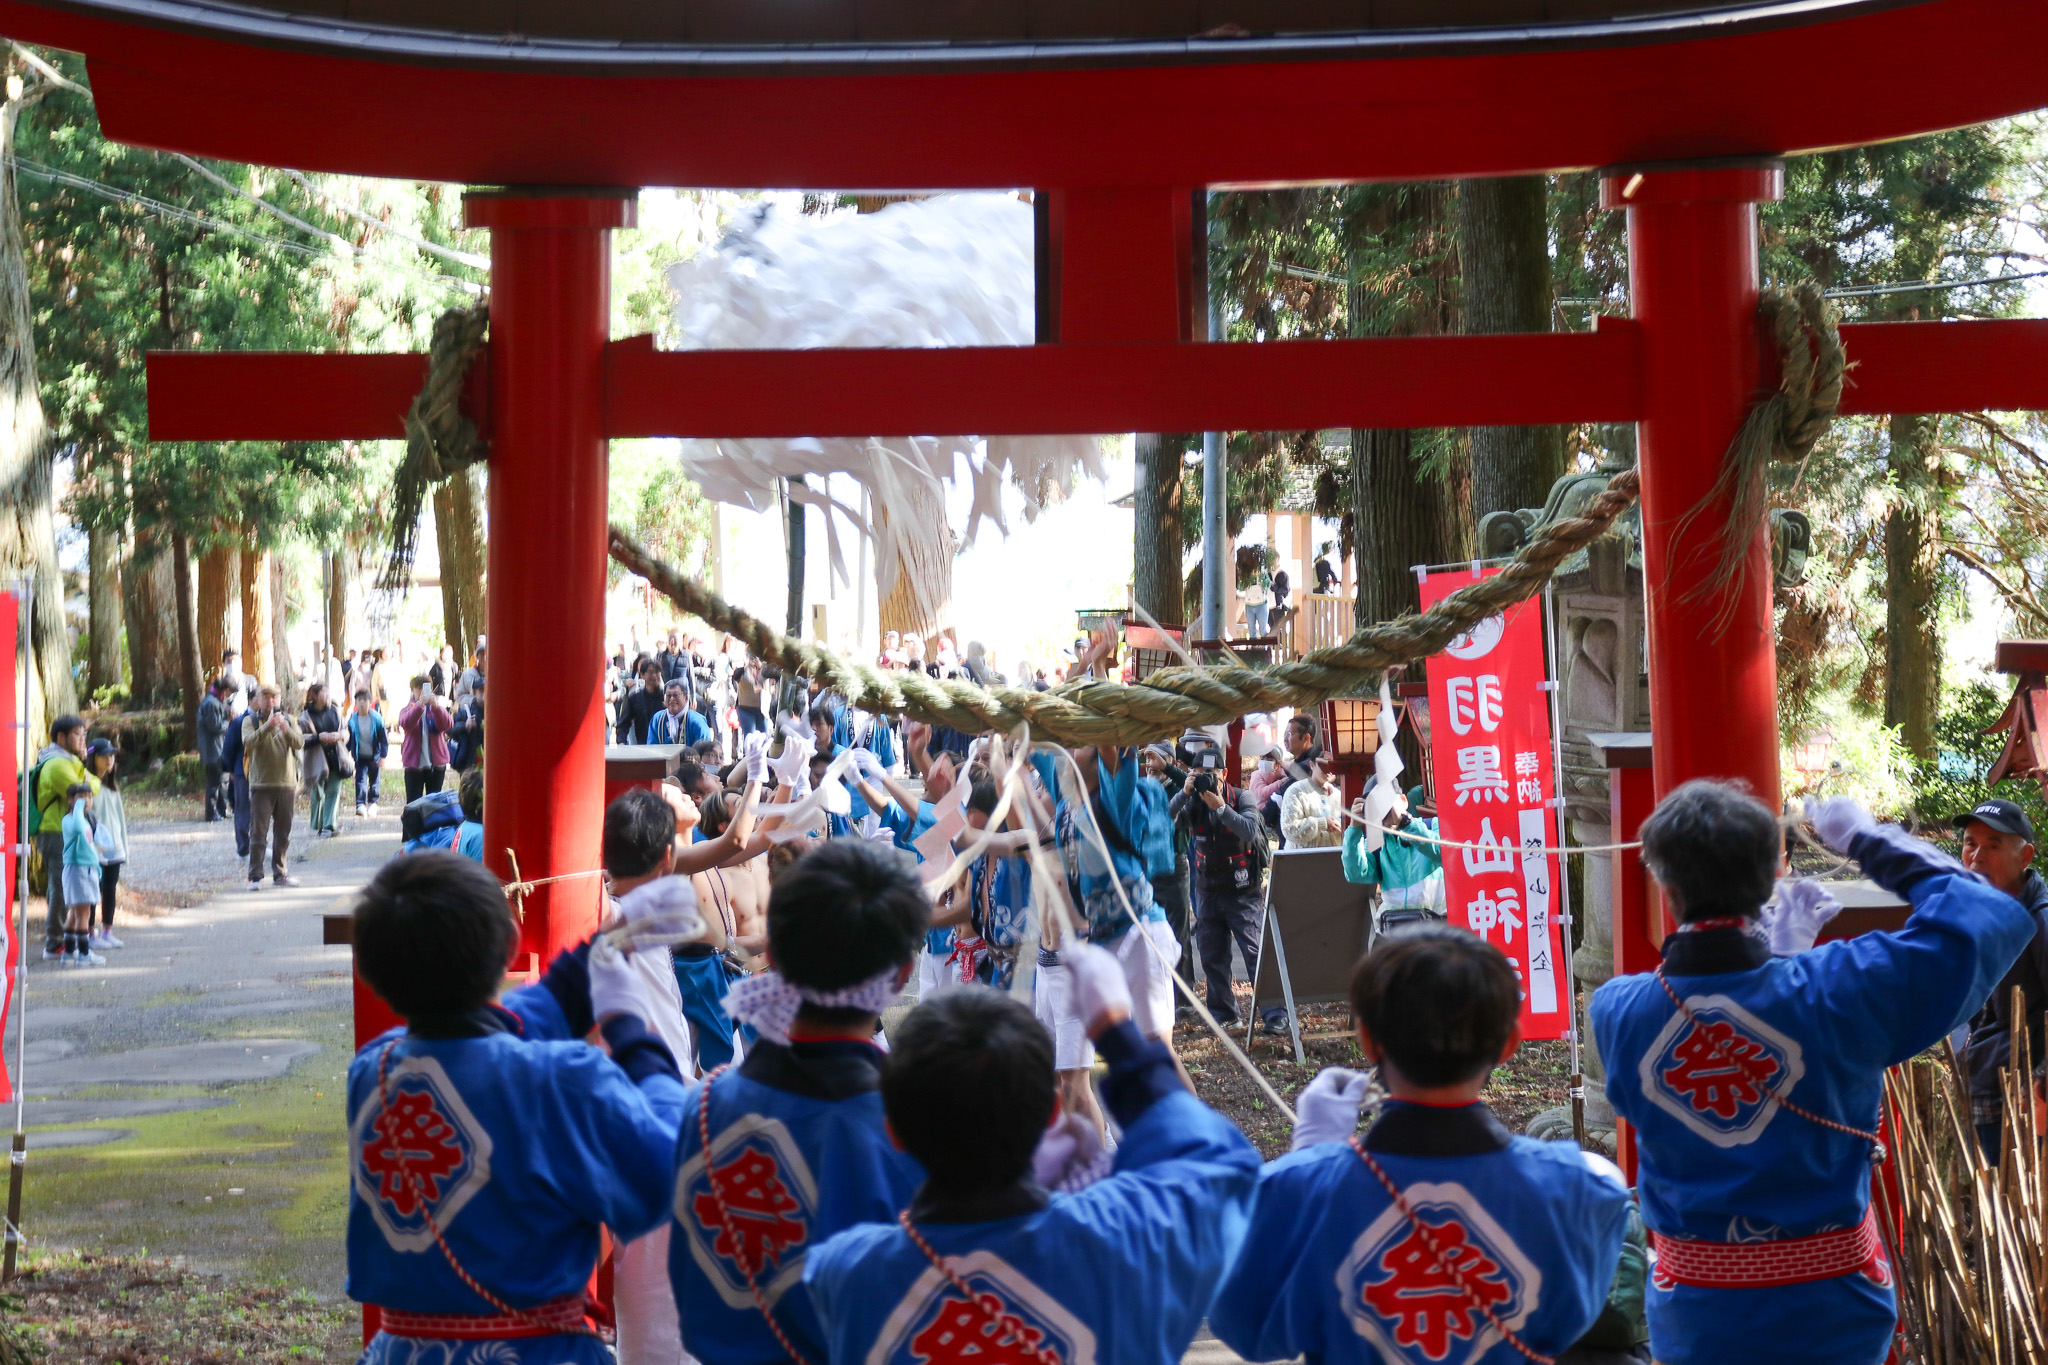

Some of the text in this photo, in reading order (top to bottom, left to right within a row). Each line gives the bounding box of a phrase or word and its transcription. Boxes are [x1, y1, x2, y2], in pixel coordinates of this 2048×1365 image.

[1664, 1021, 1779, 1119] 祭
[362, 1088, 464, 1216] 祭
[693, 1146, 807, 1274] 祭
[1362, 1220, 1511, 1361] 祭
